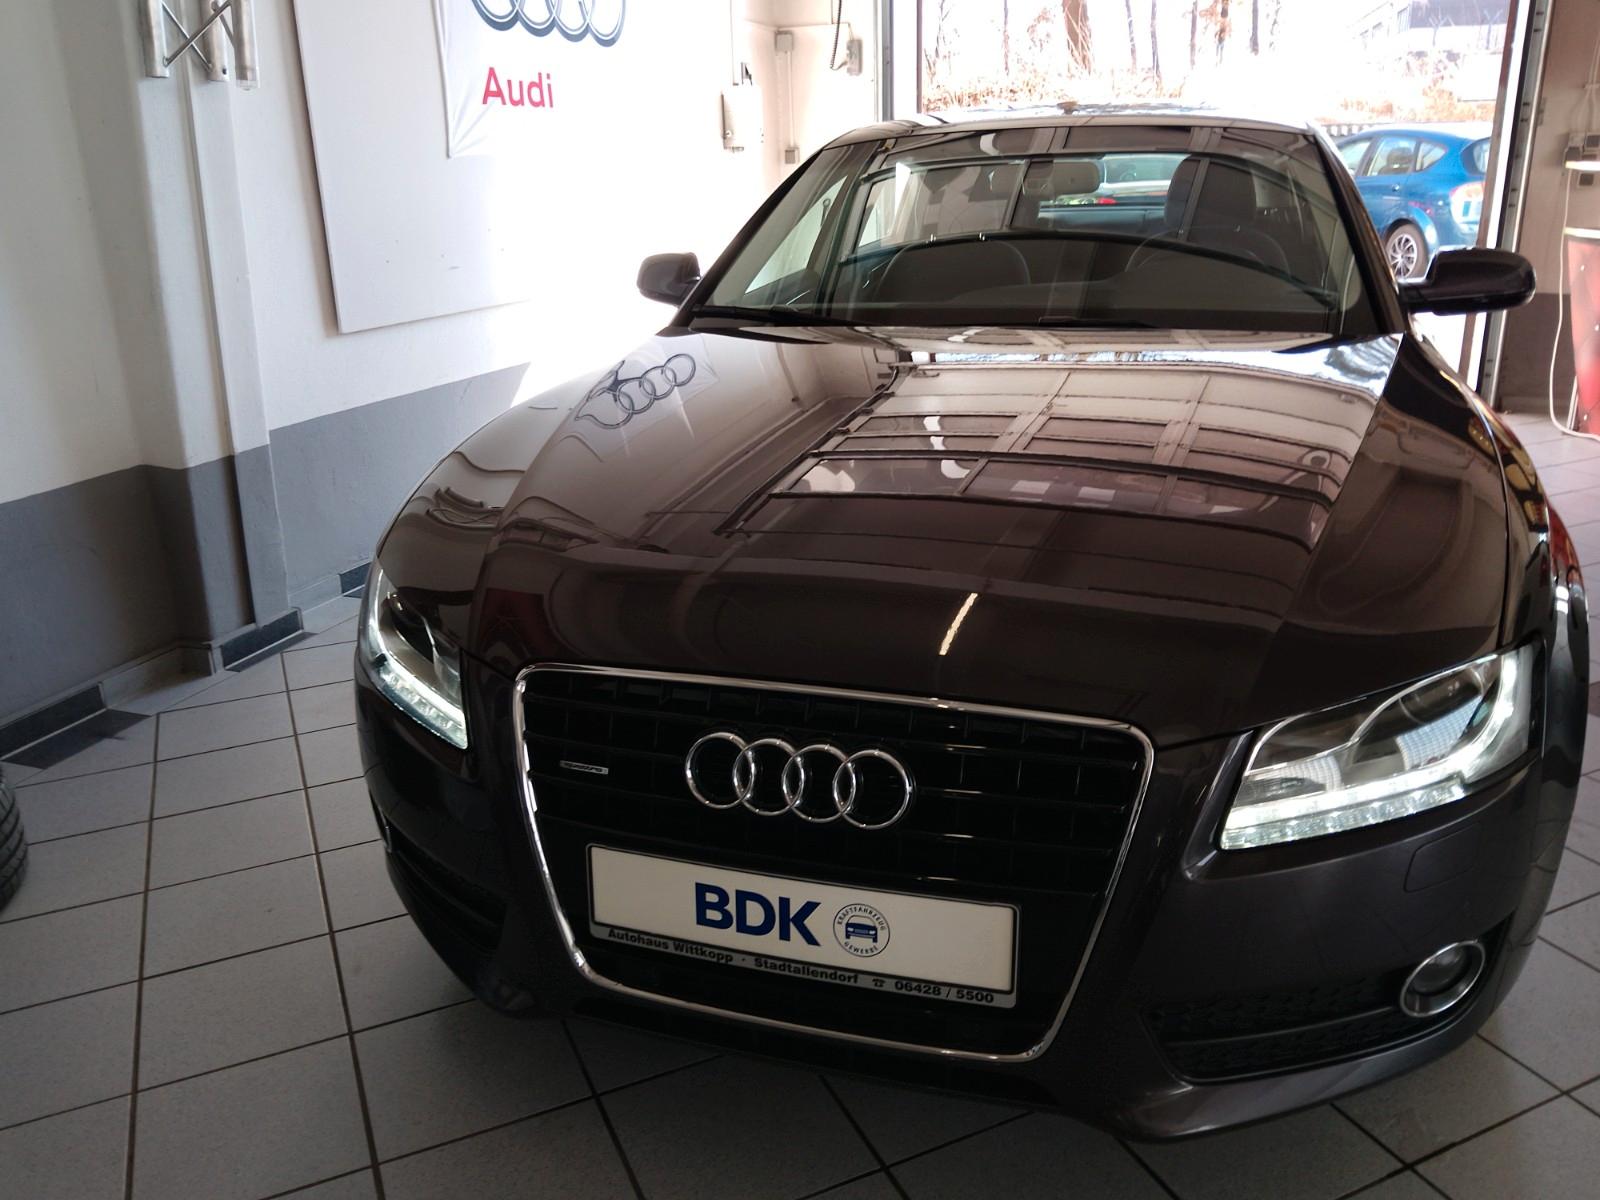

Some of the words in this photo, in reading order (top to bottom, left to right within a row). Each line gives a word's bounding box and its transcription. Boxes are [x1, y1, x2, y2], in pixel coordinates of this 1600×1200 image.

[482, 66, 554, 108] Audi
[695, 882, 821, 947] BDK
[608, 927, 669, 950] Autohaus
[673, 941, 734, 963] Wittkopp
[754, 957, 859, 983] Stadtallendorf
[895, 980, 942, 996] 06428
[956, 989, 994, 1003] 5500
